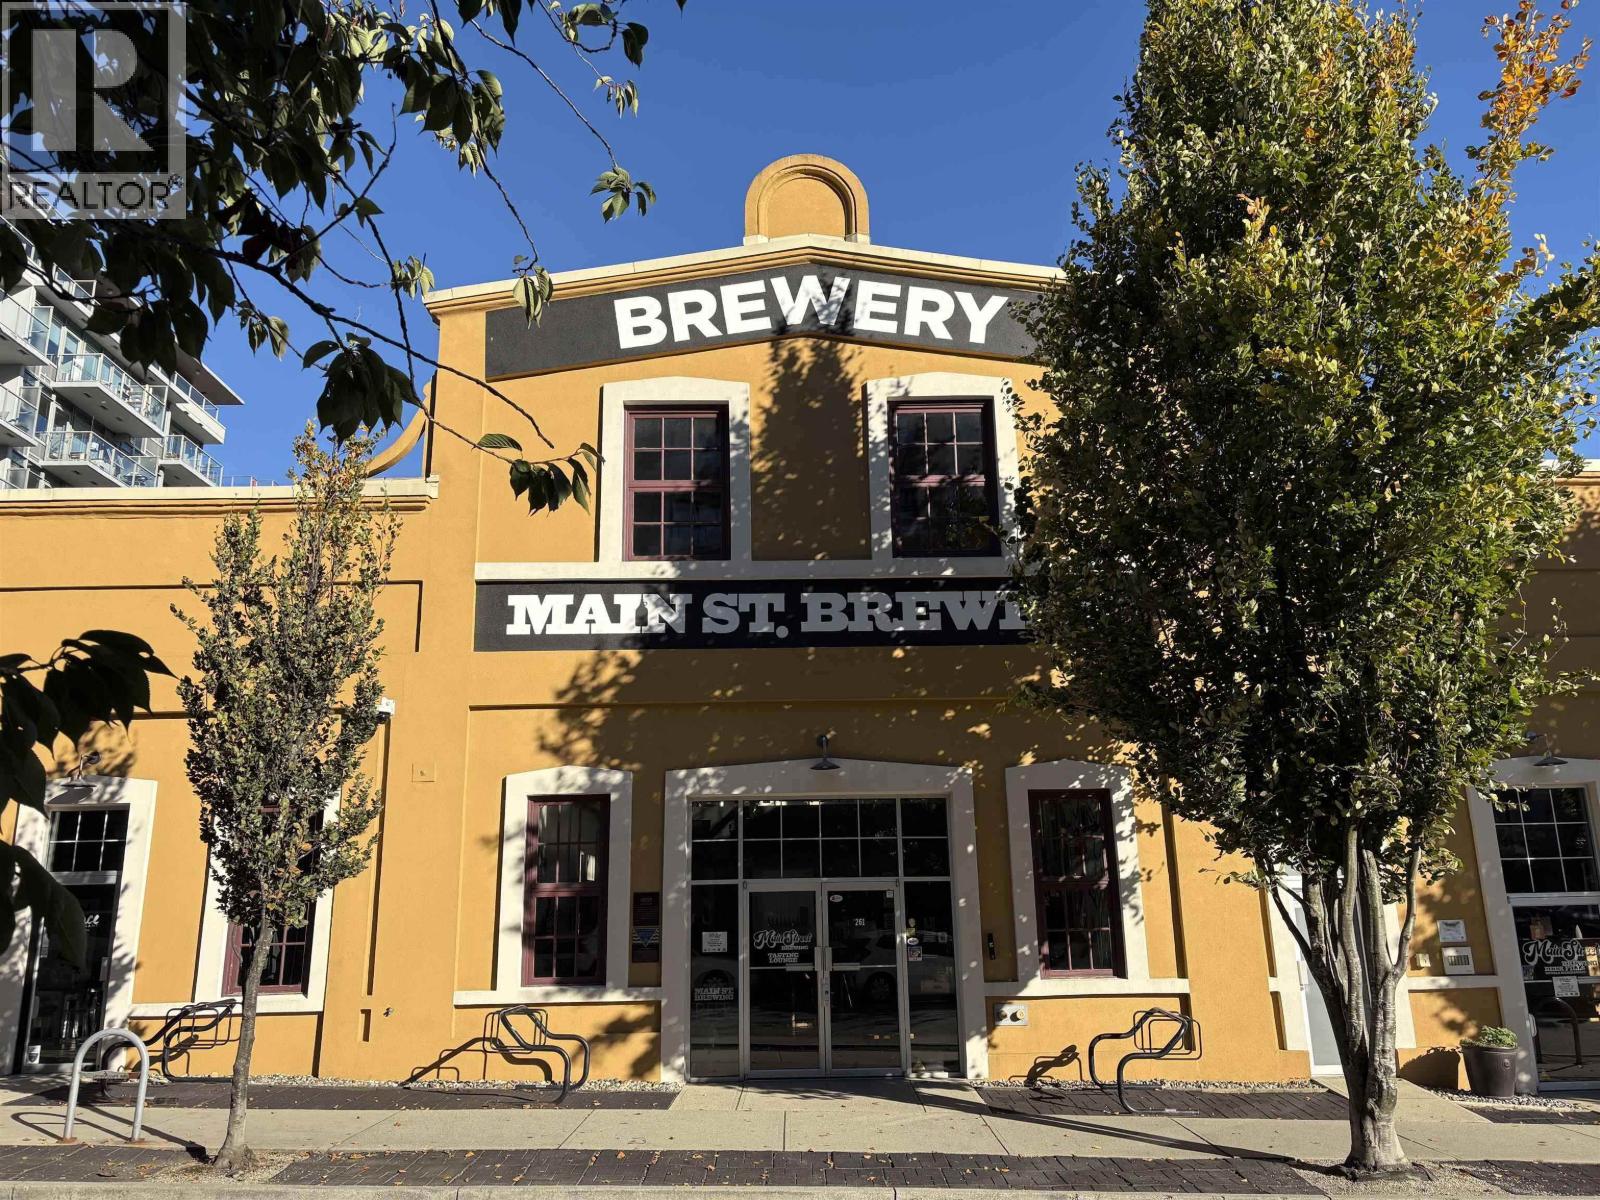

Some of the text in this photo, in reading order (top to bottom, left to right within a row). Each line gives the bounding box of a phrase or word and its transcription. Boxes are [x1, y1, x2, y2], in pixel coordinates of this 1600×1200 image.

[612, 273, 1009, 349] BREWERY
[506, 589, 1033, 639] MAIN ST. BREWI
[855, 918, 865, 926] 261
[1523, 940, 1561, 965] Main
